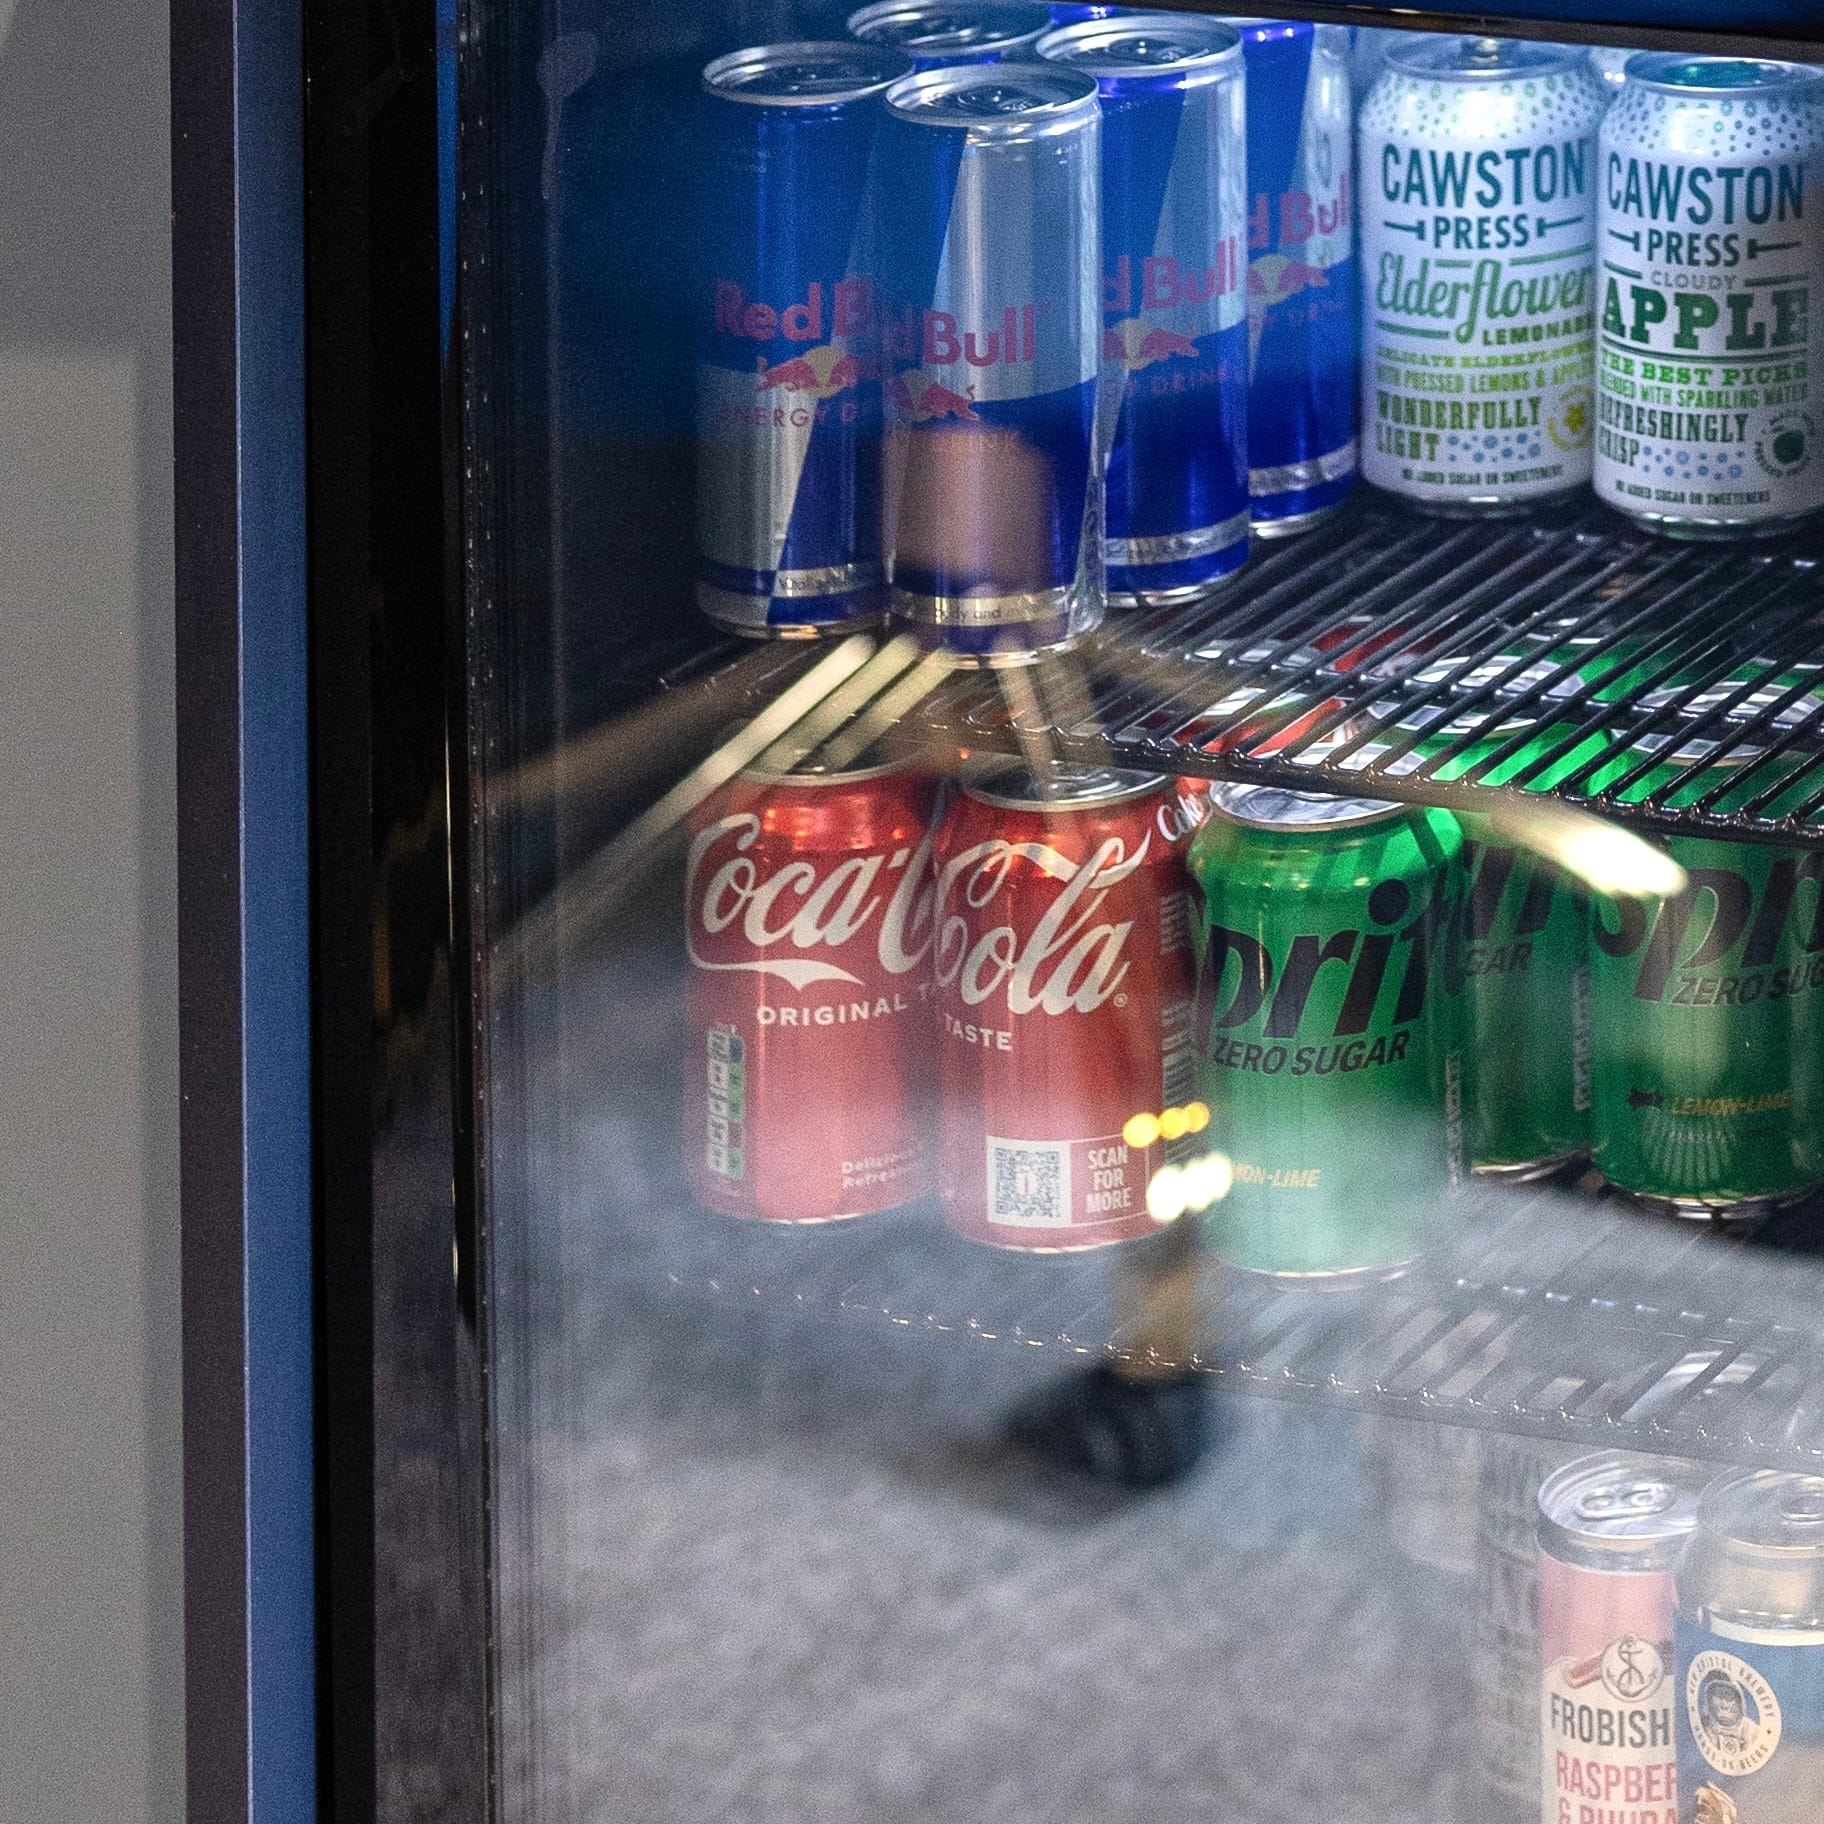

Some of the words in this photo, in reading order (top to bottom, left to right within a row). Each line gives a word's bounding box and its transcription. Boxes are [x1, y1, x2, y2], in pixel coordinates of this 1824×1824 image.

[1383, 138, 1590, 208] CAWSTON
[1608, 151, 1803, 225] CAWSTON
[1433, 213, 1529, 249] PRESS
[1647, 228, 1740, 267] PRESS
[1376, 252, 1594, 344] Elderflower
[1651, 270, 1737, 290] CLOUDY
[714, 280, 823, 341] Red
[1602, 276, 1809, 350] APPLE
[921, 304, 1036, 367] Bull
[1641, 361, 1712, 386] BEST
[1376, 389, 1542, 430] WONDERFULLY
[1671, 973, 1765, 1006] ZERO
[757, 993, 908, 1027] ORIGINAL
[945, 1013, 1013, 1051] TASTE
[1213, 1036, 1289, 1074] ZERO
[1291, 1030, 1411, 1075] SUGAR
[1087, 1146, 1129, 1169] SCAN
[1093, 1168, 1125, 1190] FOR
[1086, 1187, 1132, 1213] MORE
[1739, 1666, 1775, 1719] BREWERY
